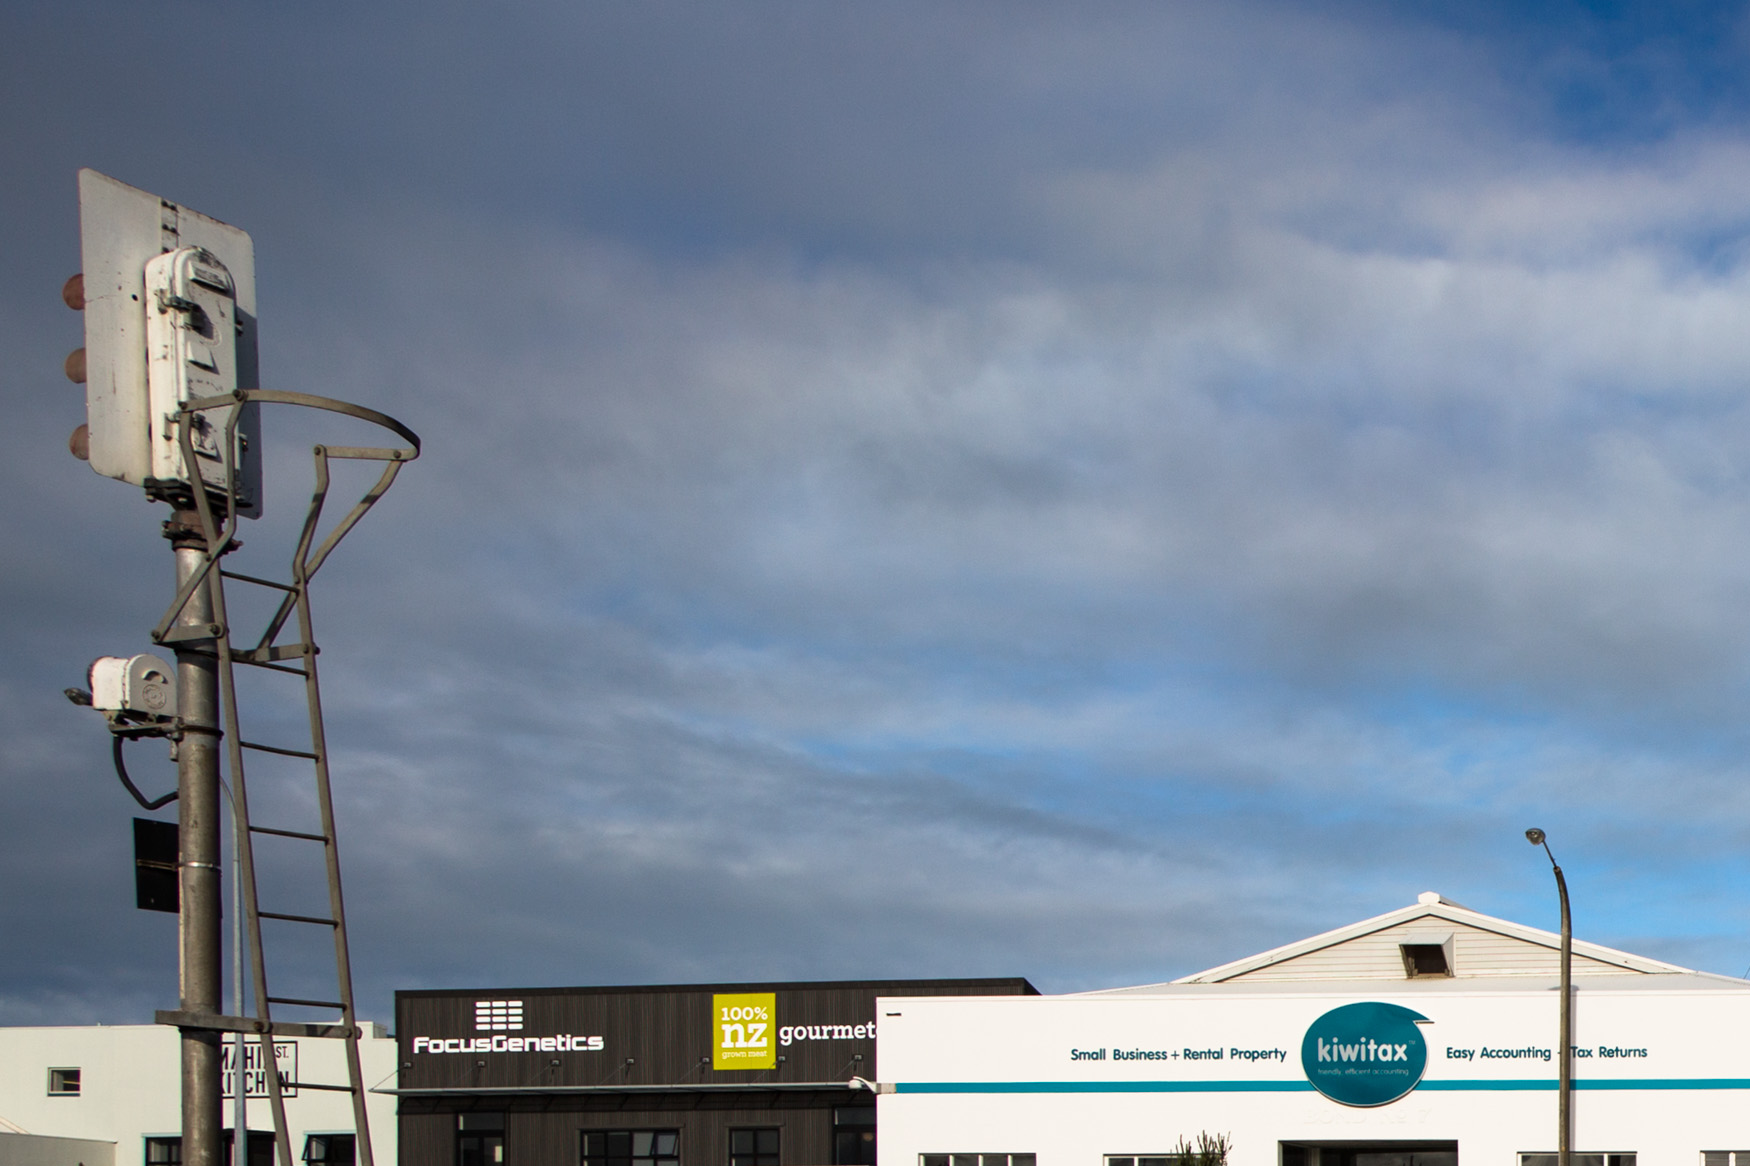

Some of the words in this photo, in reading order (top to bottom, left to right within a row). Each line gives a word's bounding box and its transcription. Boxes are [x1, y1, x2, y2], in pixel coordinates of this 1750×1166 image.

[721, 1006, 768, 1021] 100%
[721, 1022, 768, 1048] nz
[779, 1020, 877, 1046] gourmet
[275, 1046, 289, 1058] ST.
[413, 1034, 605, 1054] FocusGenetics
[1317, 1036, 1408, 1062] kiwitax
[1571, 1046, 1593, 1058] Tax
[1599, 1046, 1648, 1058] Returns
[722, 1051, 747, 1060] grown
[748, 1050, 767, 1058] meat
[1070, 1047, 1106, 1061] Small
[1113, 1047, 1168, 1061] Business
[1170, 1050, 1180, 1060] +
[1183, 1047, 1223, 1060] Rental
[1230, 1047, 1287, 1063] Property
[1446, 1046, 1475, 1062] Easy
[1480, 1046, 1551, 1062] Accounting
